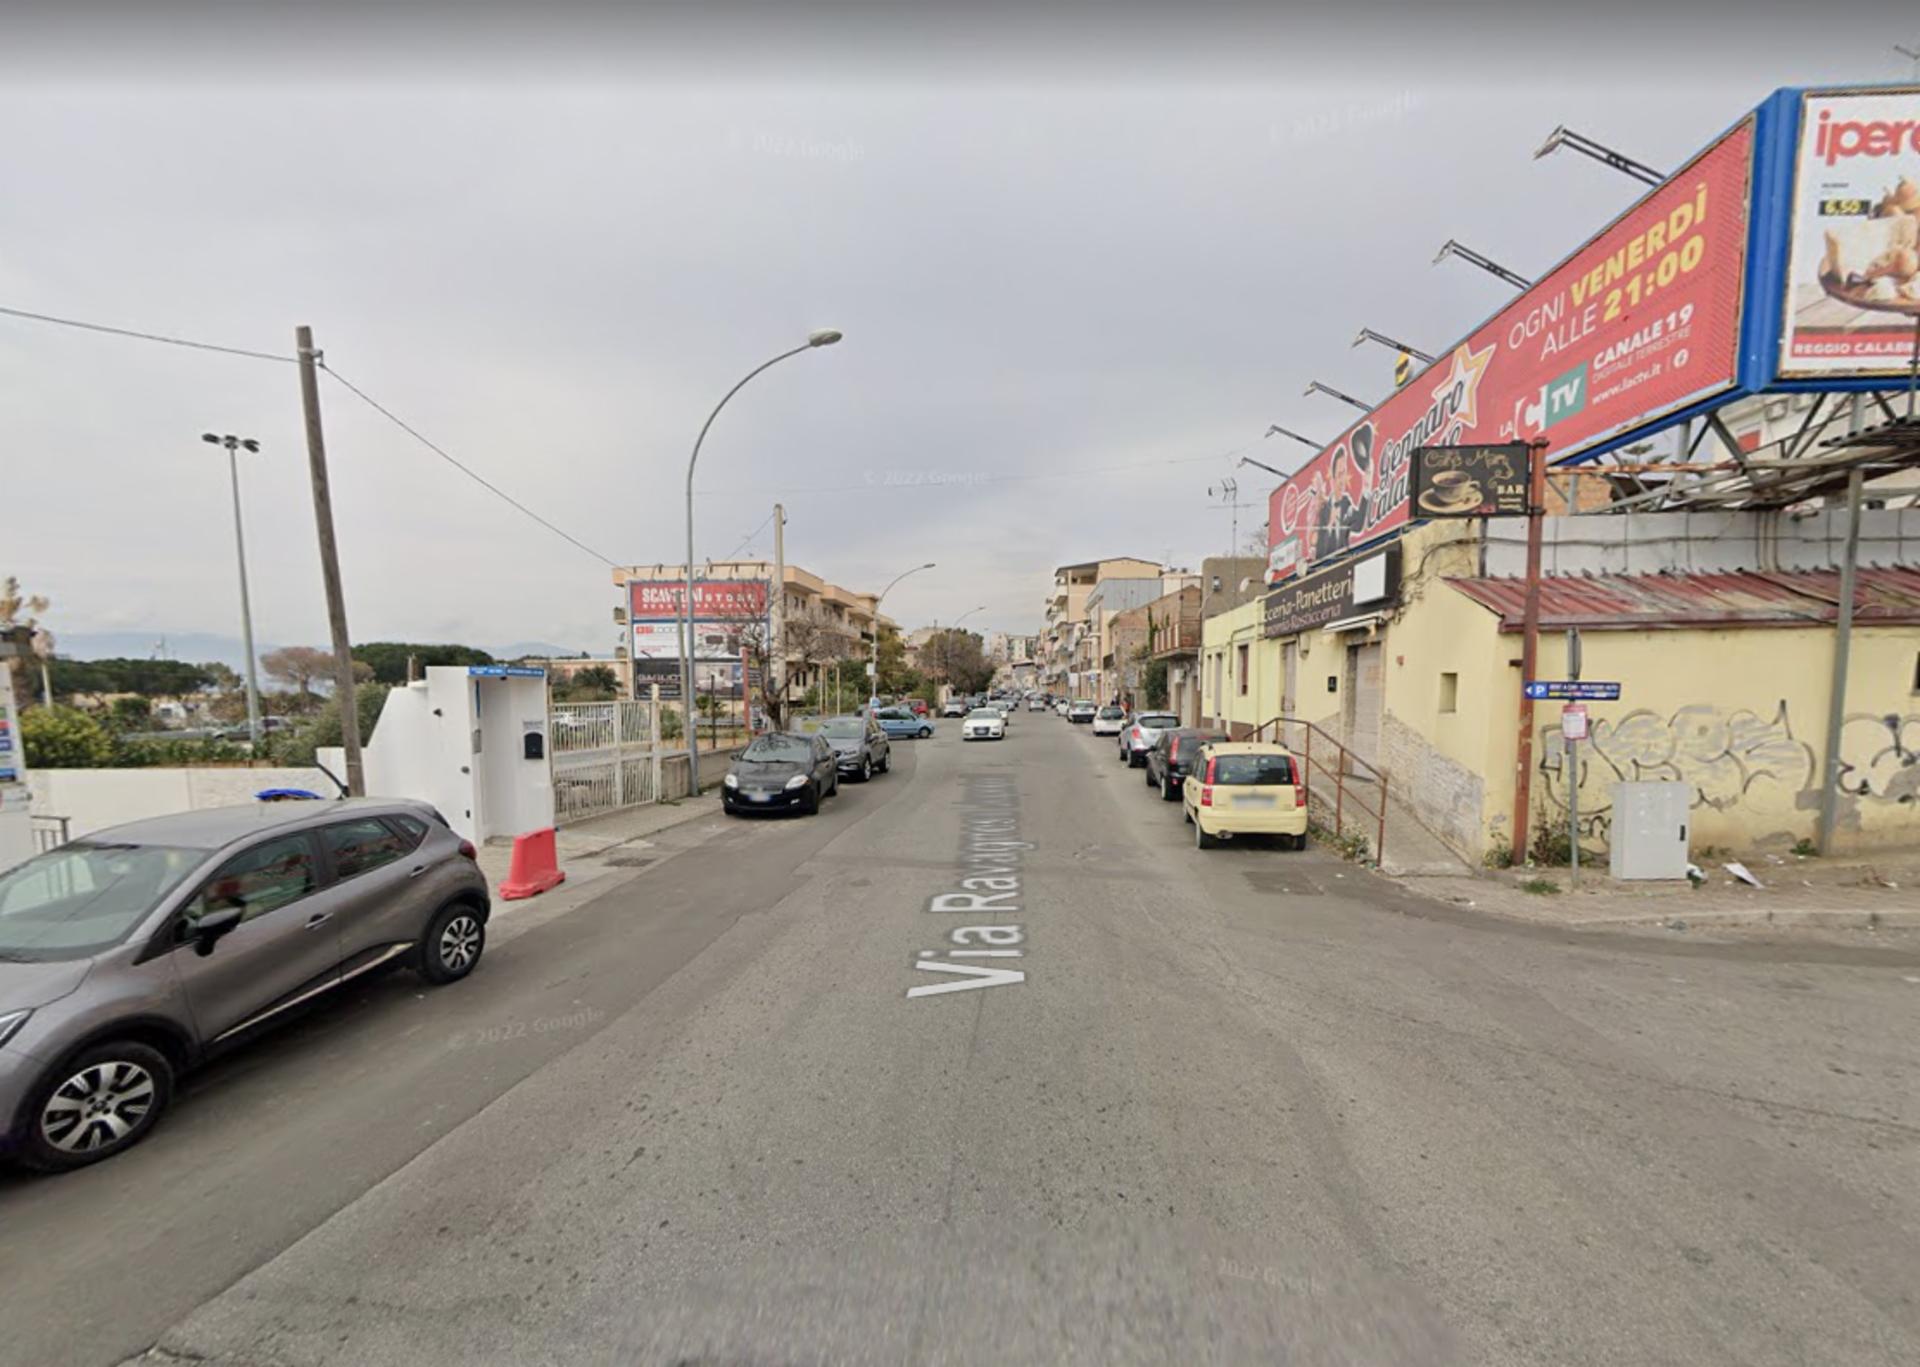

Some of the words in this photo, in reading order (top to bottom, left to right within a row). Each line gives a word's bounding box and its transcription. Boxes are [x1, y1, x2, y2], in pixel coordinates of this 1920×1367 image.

[1508, 291, 1565, 350] OGNI
[1570, 182, 1708, 307] VENERDÌ
[1540, 302, 1598, 362] ALLE
[1603, 234, 1705, 323] 21:00
[1593, 319, 1663, 370] CANALE
[1665, 303, 1694, 332] 19
[1794, 342, 1851, 354] REGGIO
[1551, 377, 1582, 414] TV
[1379, 380, 1465, 477] Gennaro
[1497, 484, 1525, 495] BAR
[642, 587, 703, 603] SCAVLINI
